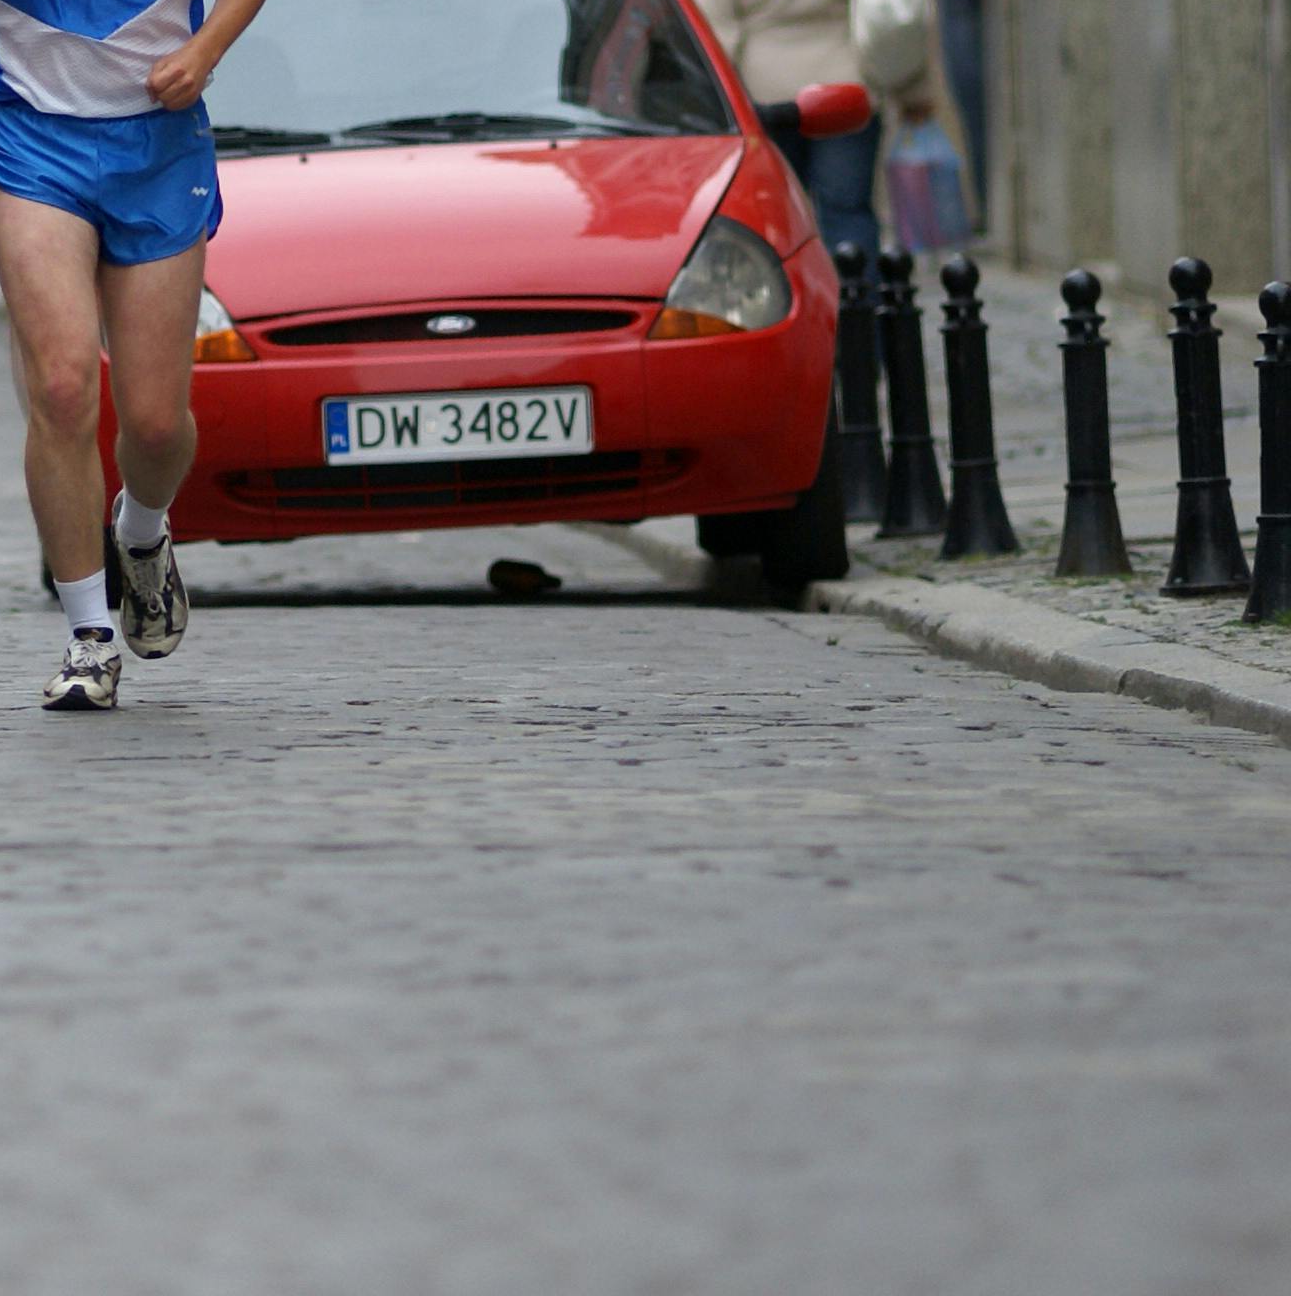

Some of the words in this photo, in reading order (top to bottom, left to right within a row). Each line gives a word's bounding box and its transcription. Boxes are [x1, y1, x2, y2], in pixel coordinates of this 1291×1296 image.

[356, 405, 419, 449] DW
[440, 397, 578, 444] 3482V
[330, 433, 347, 448] PL
